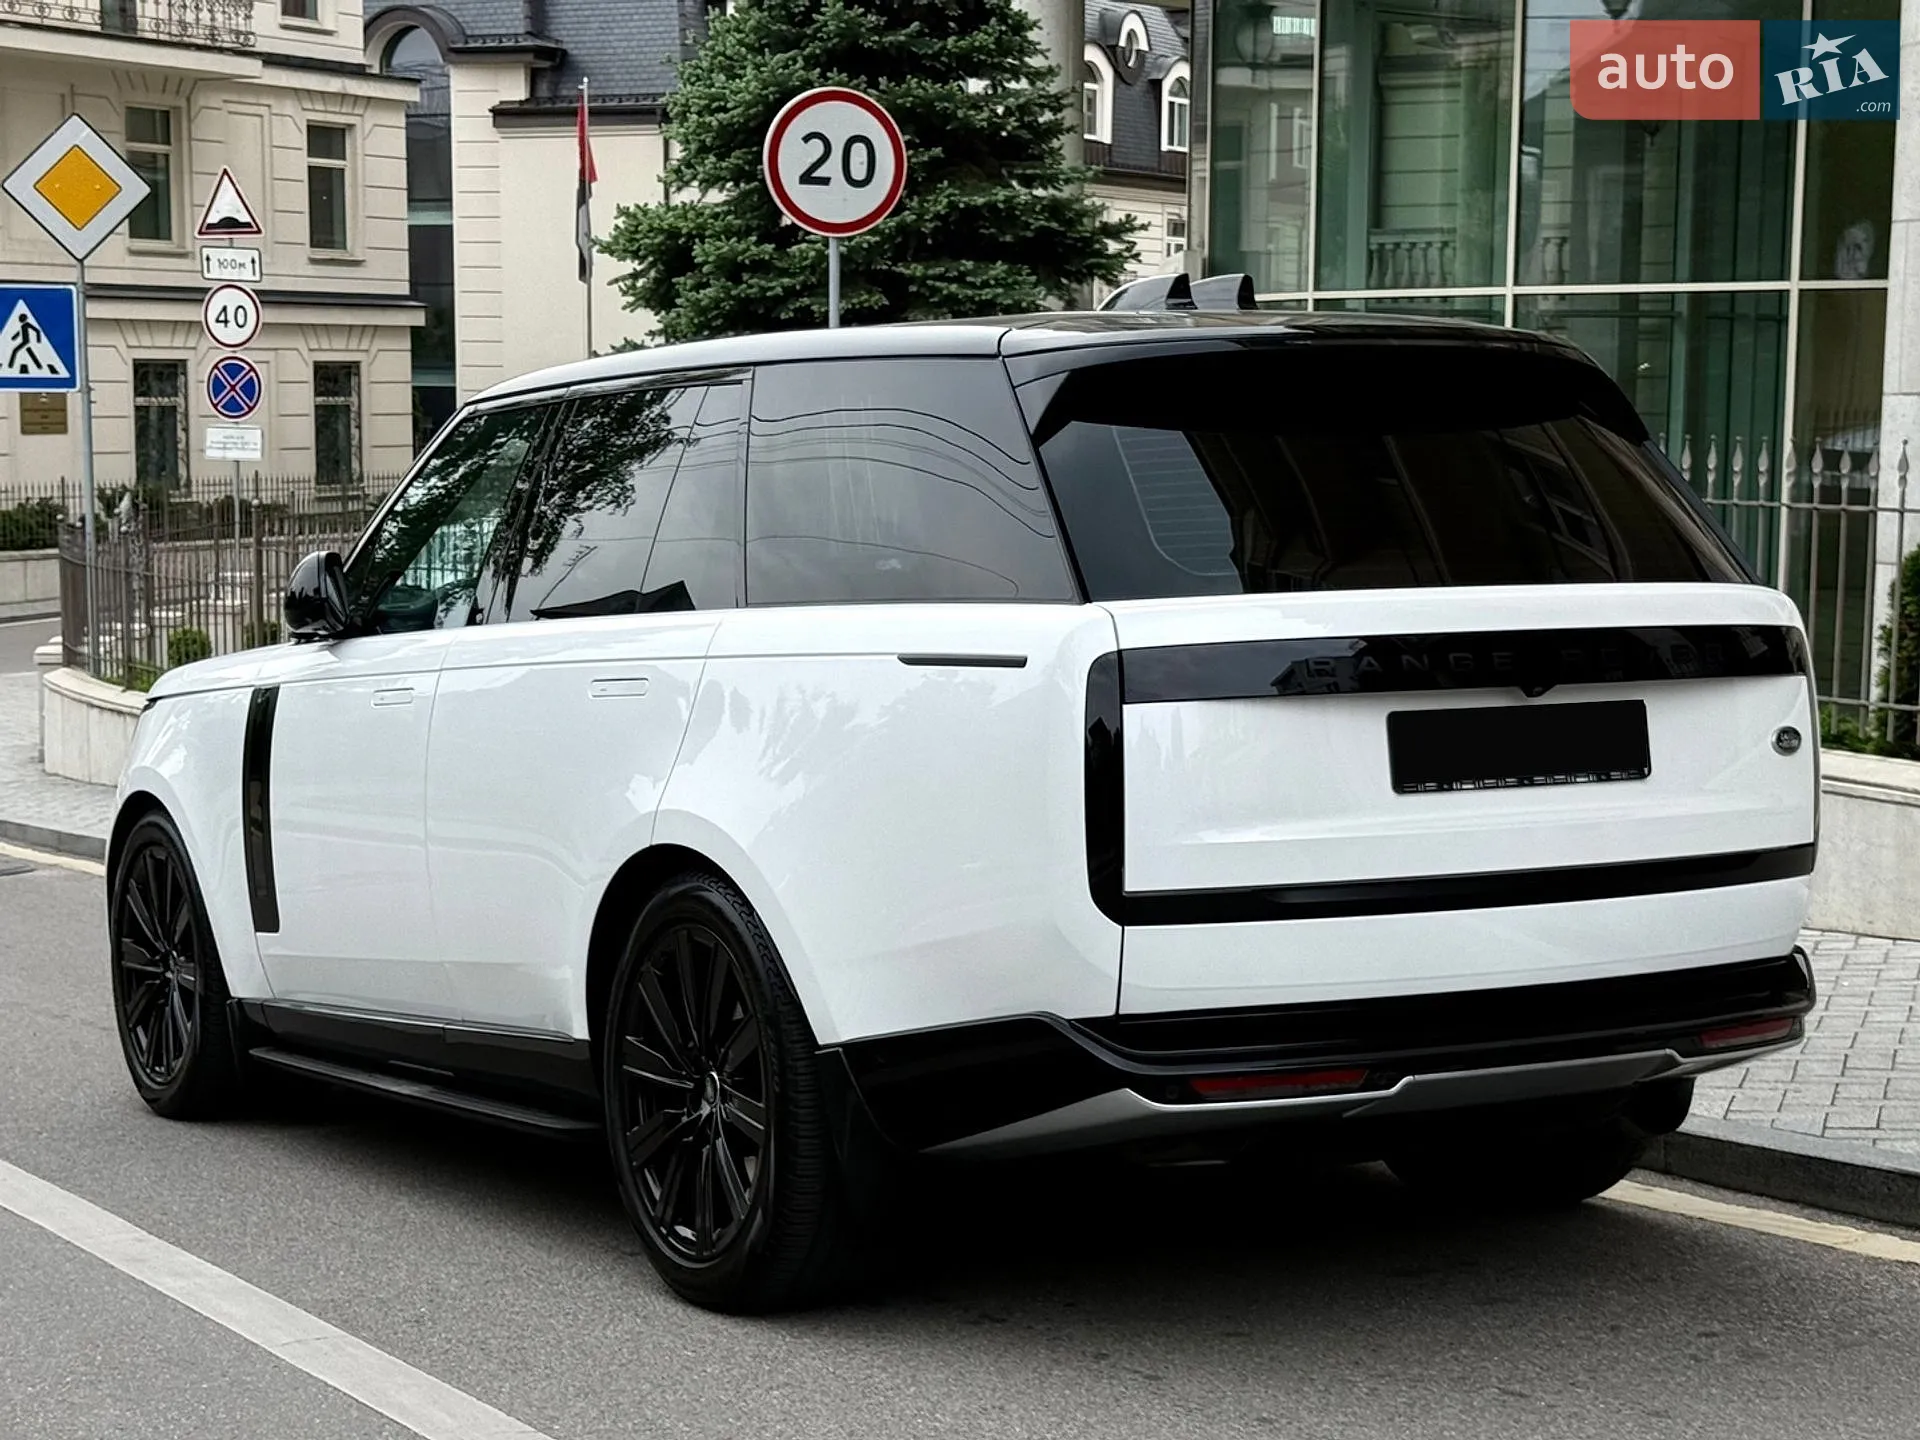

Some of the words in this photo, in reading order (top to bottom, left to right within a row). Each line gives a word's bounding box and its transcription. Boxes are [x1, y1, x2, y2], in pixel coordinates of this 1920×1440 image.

[799, 131, 876, 189] 20
[215, 304, 248, 328] 40
[1308, 652, 1514, 678] RANGE
